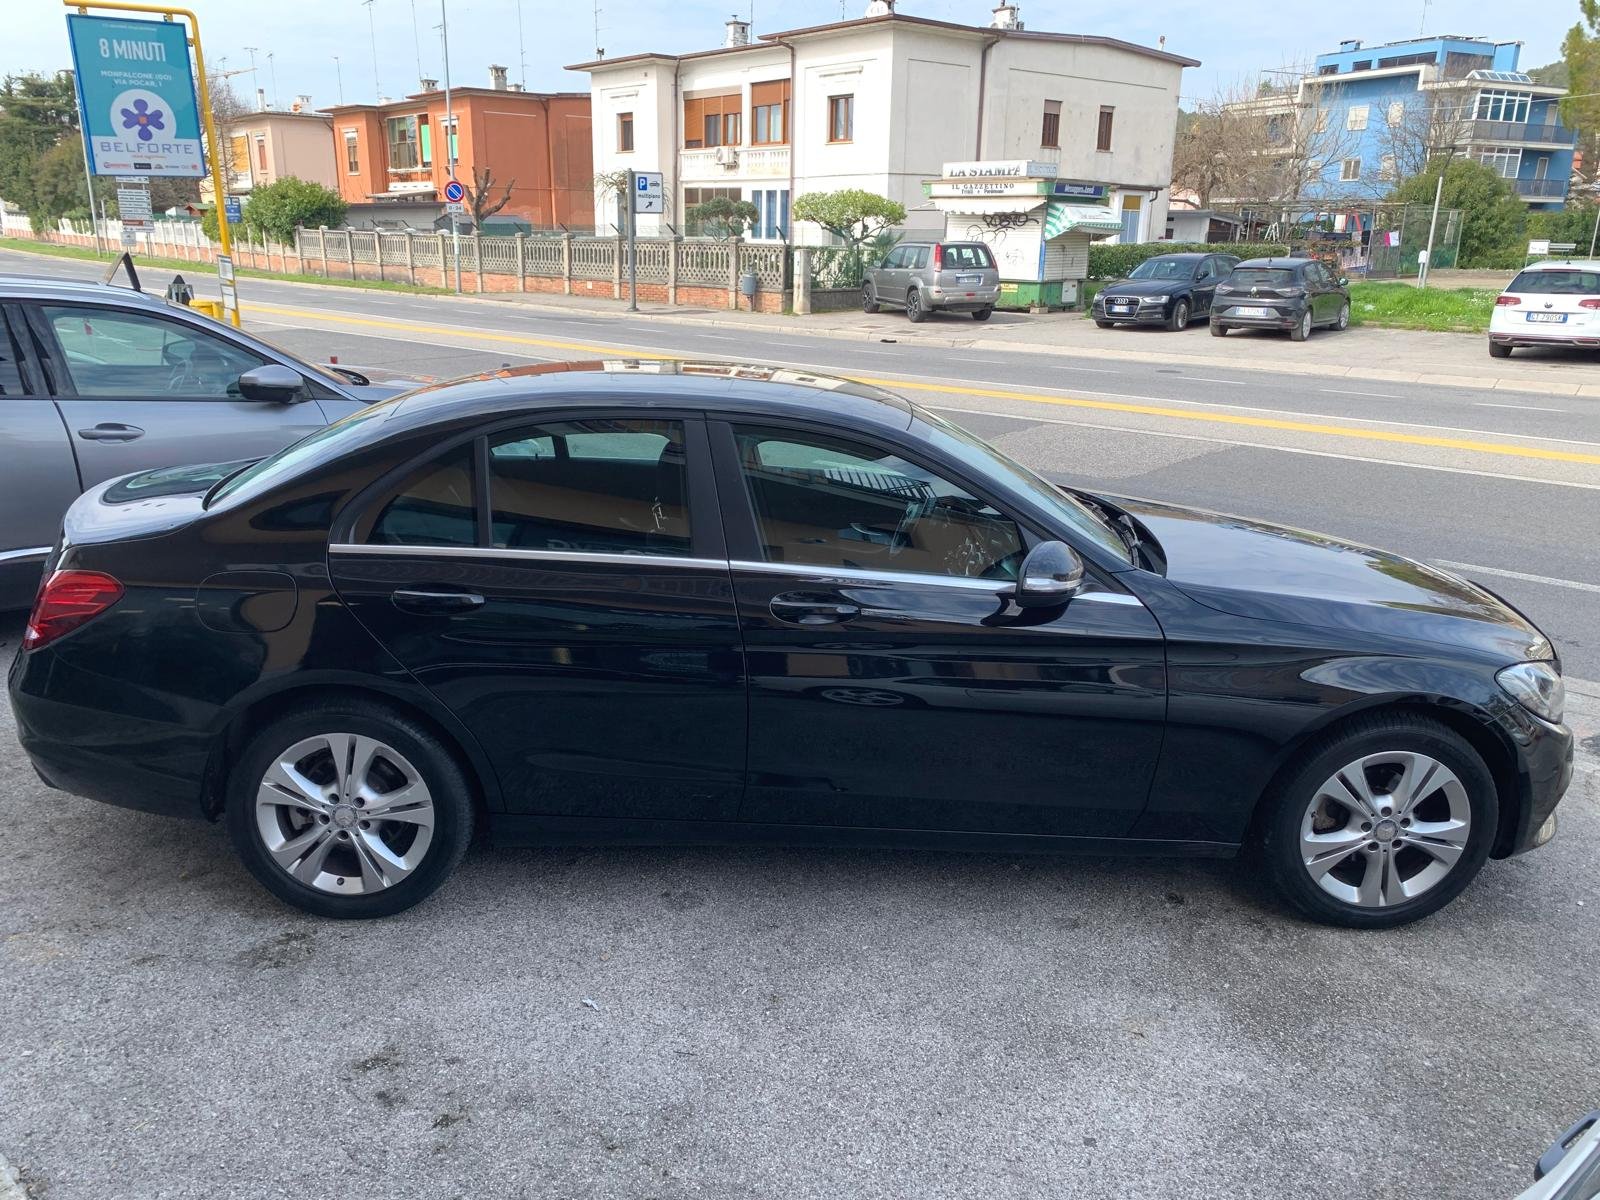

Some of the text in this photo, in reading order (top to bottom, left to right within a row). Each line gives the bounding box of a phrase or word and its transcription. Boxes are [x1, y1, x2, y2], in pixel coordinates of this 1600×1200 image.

[99, 38, 167, 62] 8 MINUTI
[101, 70, 153, 80] MONFALCONE
[100, 141, 194, 154] BELFORTE
[949, 167, 967, 177] LA
[639, 178, 646, 189] P
